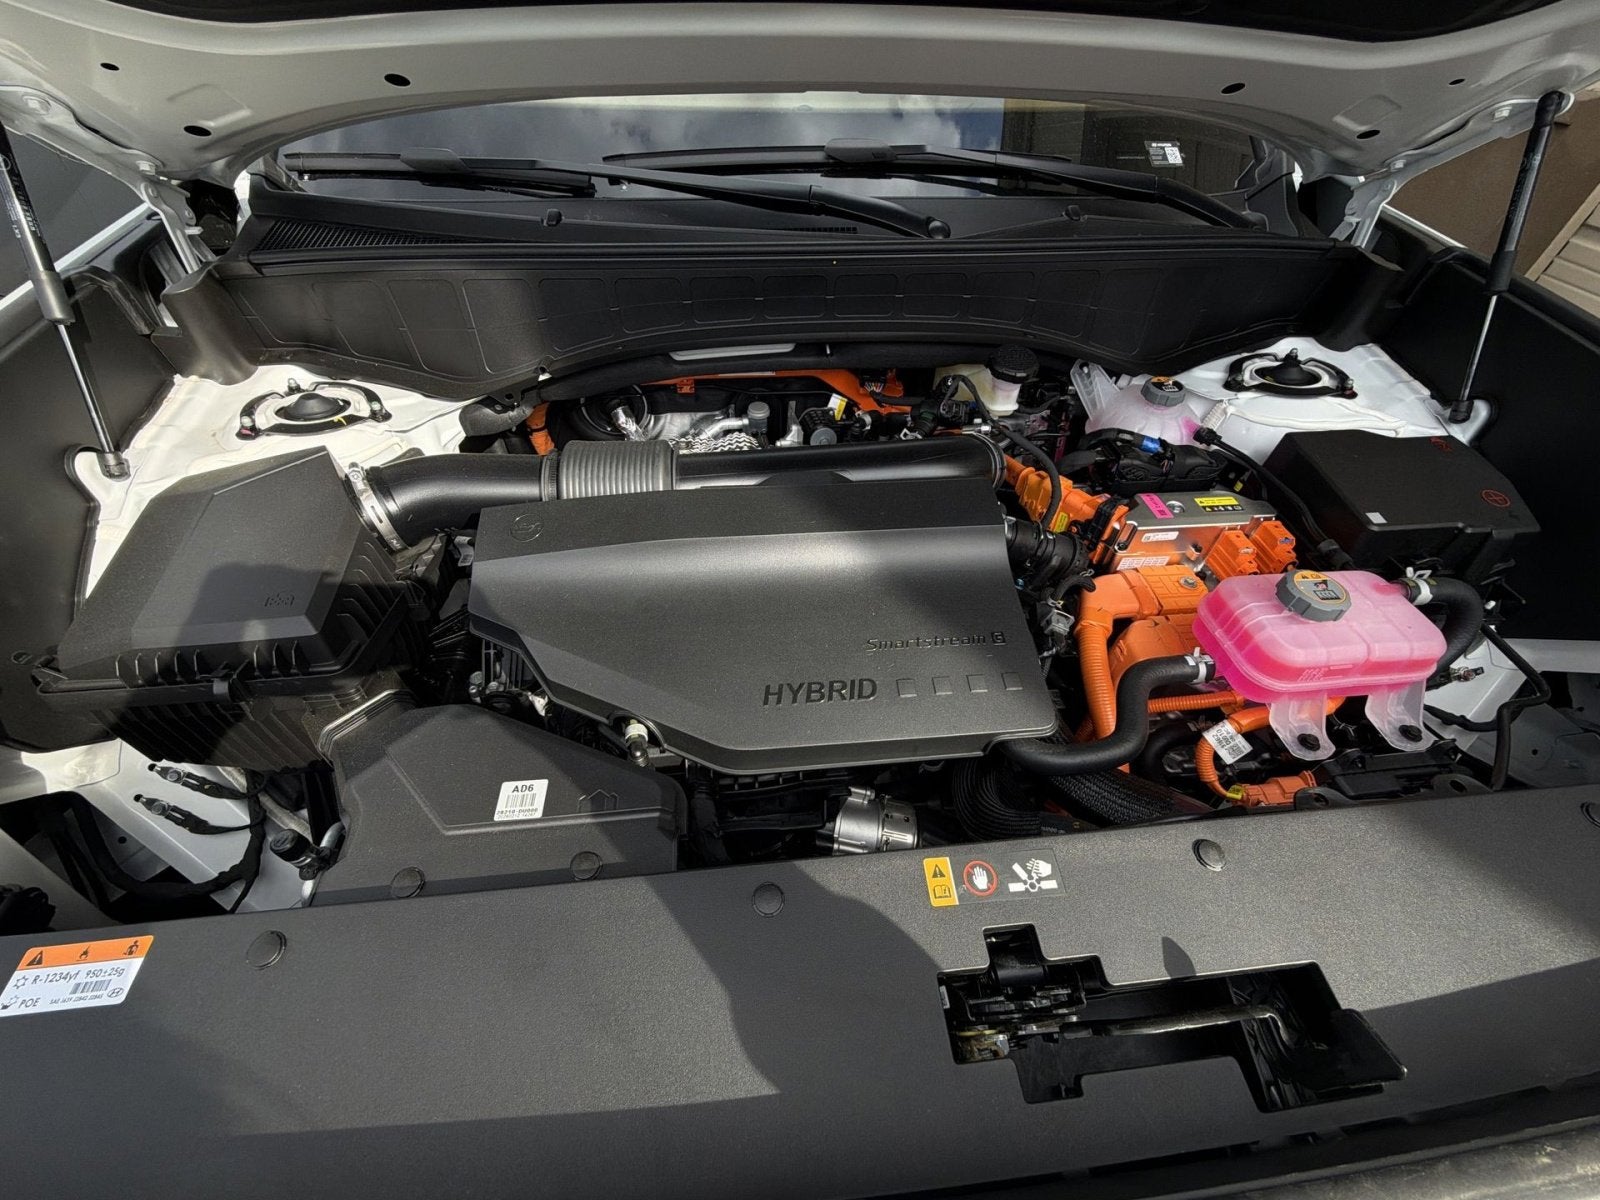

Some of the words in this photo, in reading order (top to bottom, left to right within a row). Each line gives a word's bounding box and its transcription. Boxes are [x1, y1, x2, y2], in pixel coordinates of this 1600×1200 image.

[866, 635, 986, 651] Smartstream
[763, 678, 877, 706] HYBRID
[511, 784, 534, 793] AD6
[31, 970, 79, 984] R-1234yf
[18, 998, 41, 1009] POE
